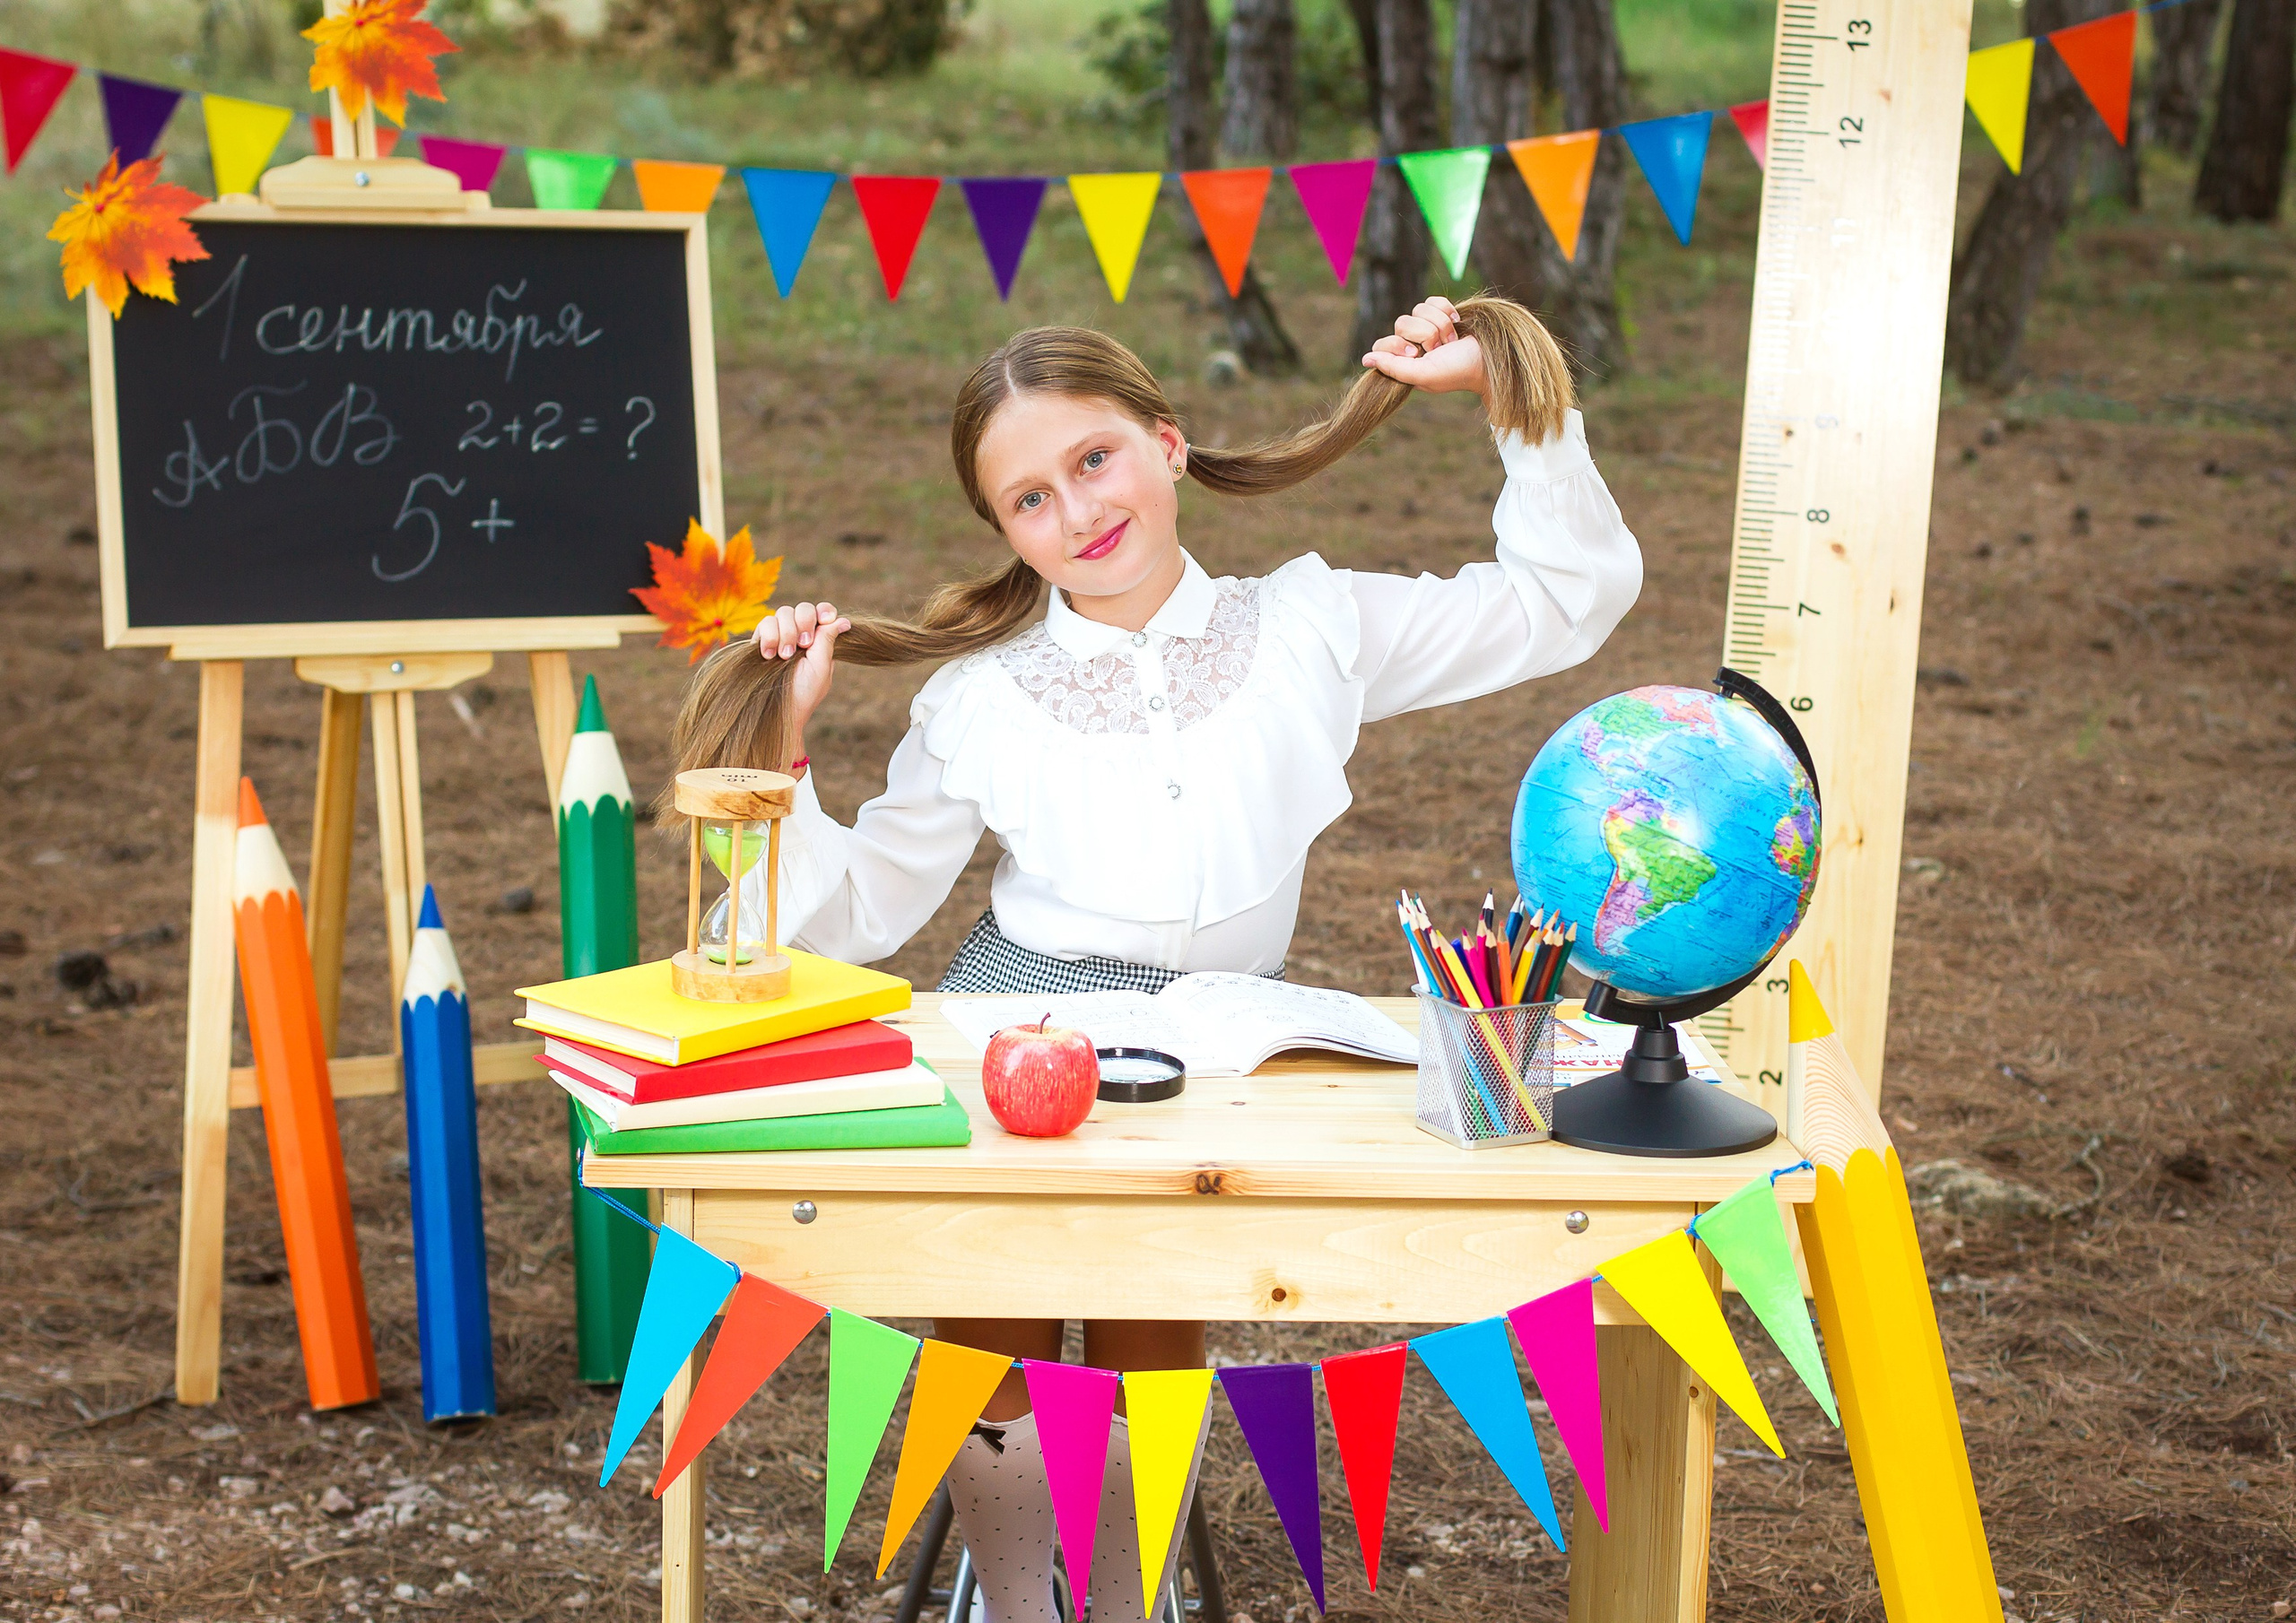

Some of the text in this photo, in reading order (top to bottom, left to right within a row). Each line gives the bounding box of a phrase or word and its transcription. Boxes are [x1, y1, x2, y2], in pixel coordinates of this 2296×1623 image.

[1846, 19, 1873, 52] 13
[1839, 116, 1865, 148] 12
[192, 254, 603, 382] 1 сентября
[1806, 508, 1831, 524] 8
[1797, 603, 1822, 617] 7
[1790, 697, 1813, 712] 6
[1767, 978, 1789, 994] 3
[1759, 1070, 1783, 1087] 2
